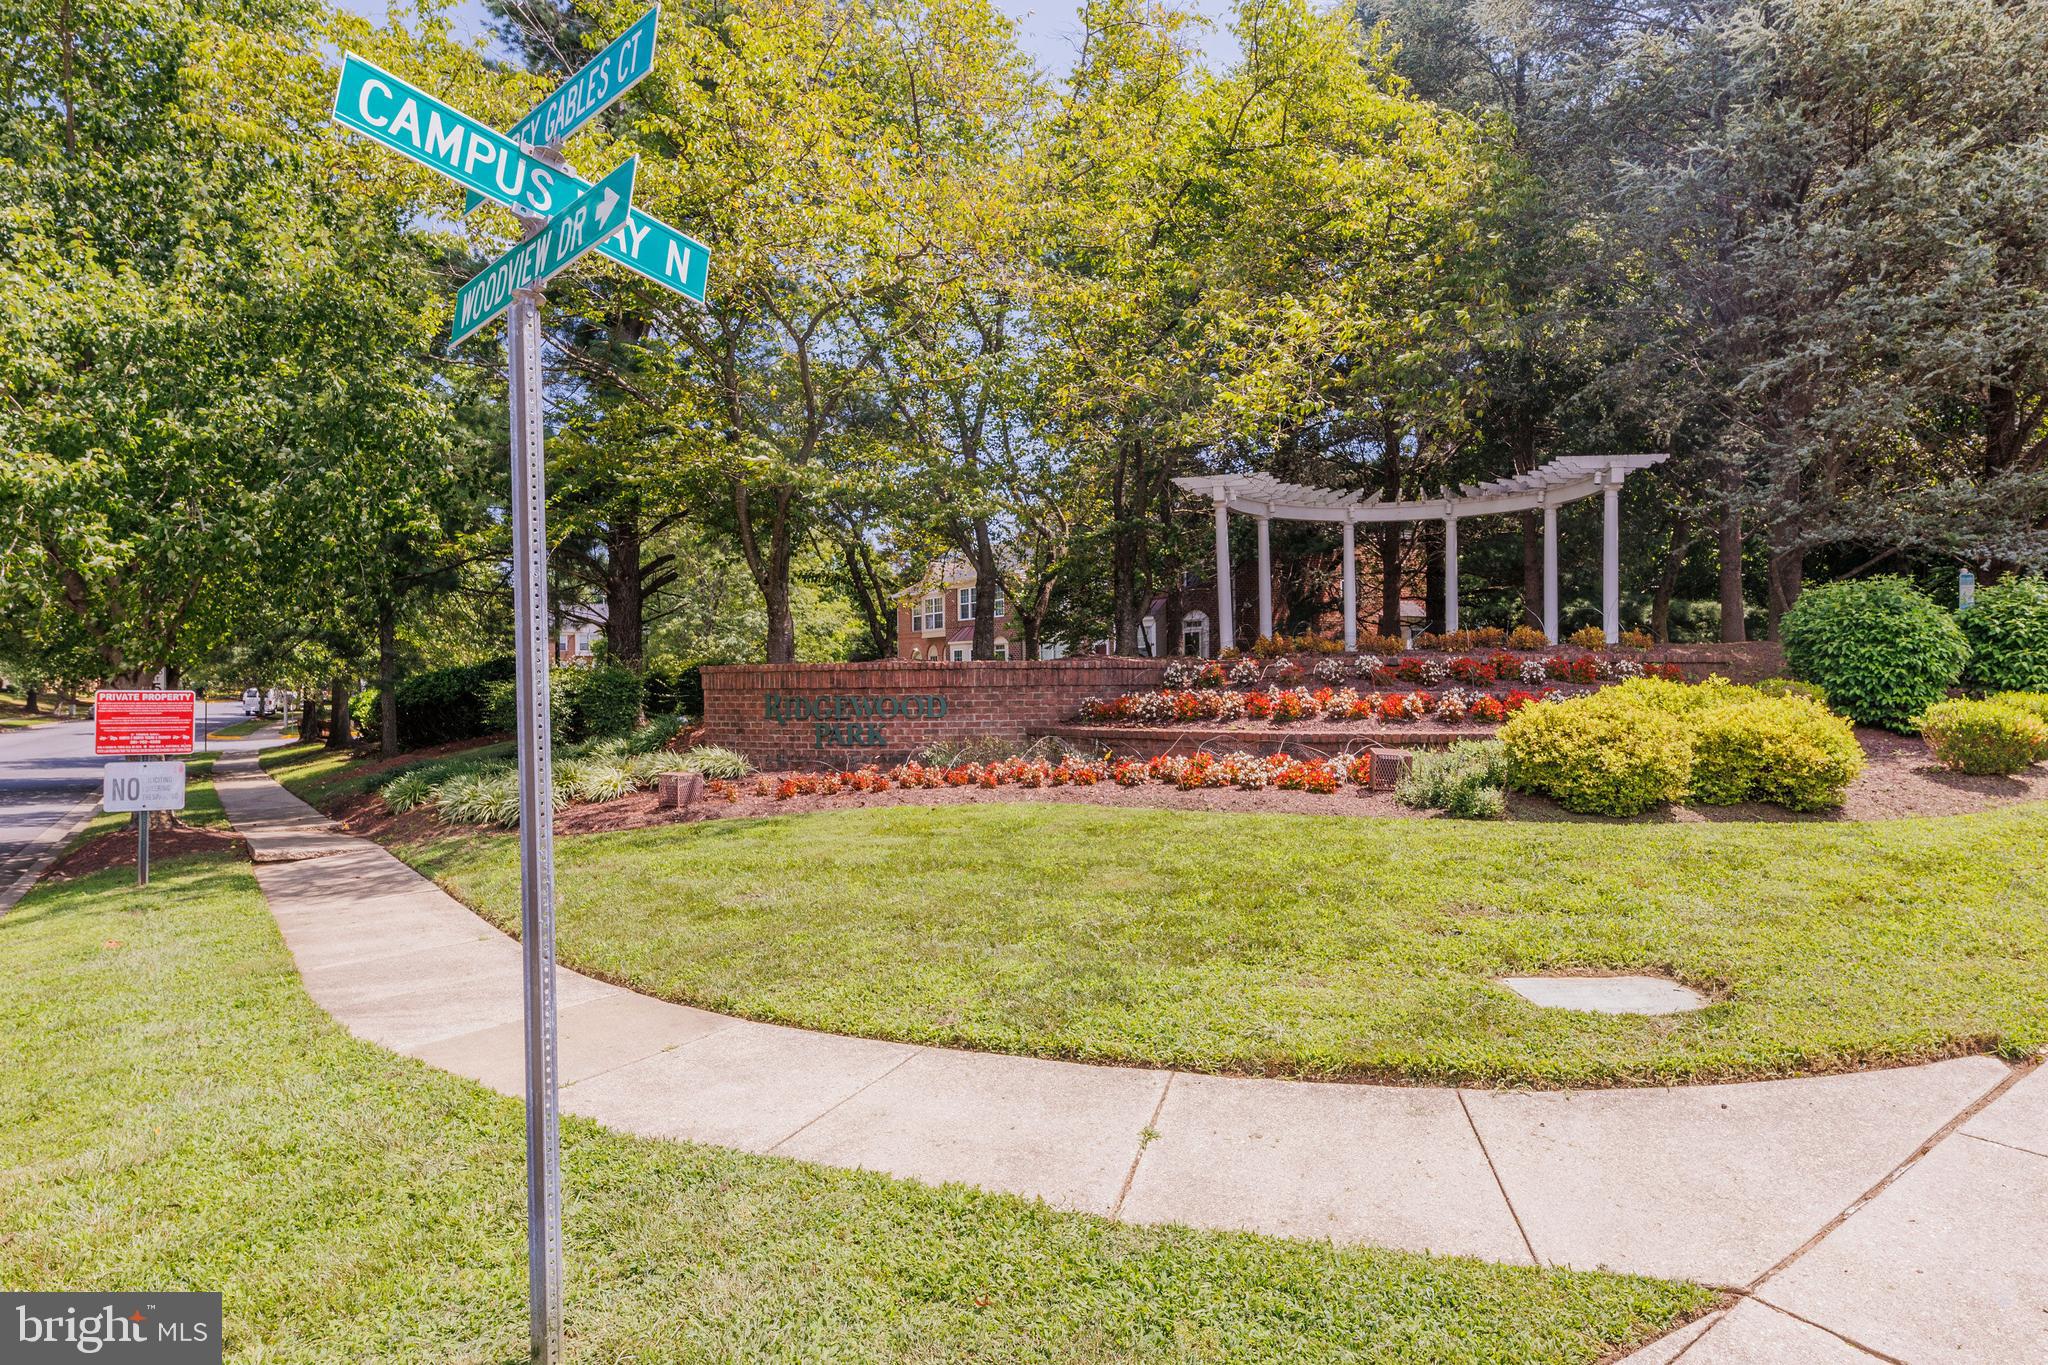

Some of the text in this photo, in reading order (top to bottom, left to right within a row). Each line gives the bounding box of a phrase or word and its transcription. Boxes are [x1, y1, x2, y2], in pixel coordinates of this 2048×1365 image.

[545, 56, 610, 142] GABLES
[617, 30, 643, 83] CT
[358, 78, 555, 211] CAMPUS
[665, 239, 691, 285] N
[461, 205, 587, 329] WOODVIEW DR
[100, 693, 191, 701] PRIVATE PROPERTY
[764, 690, 948, 725] RIDGEWOOD
[814, 722, 887, 749] PARK
[111, 777, 141, 802] NO
